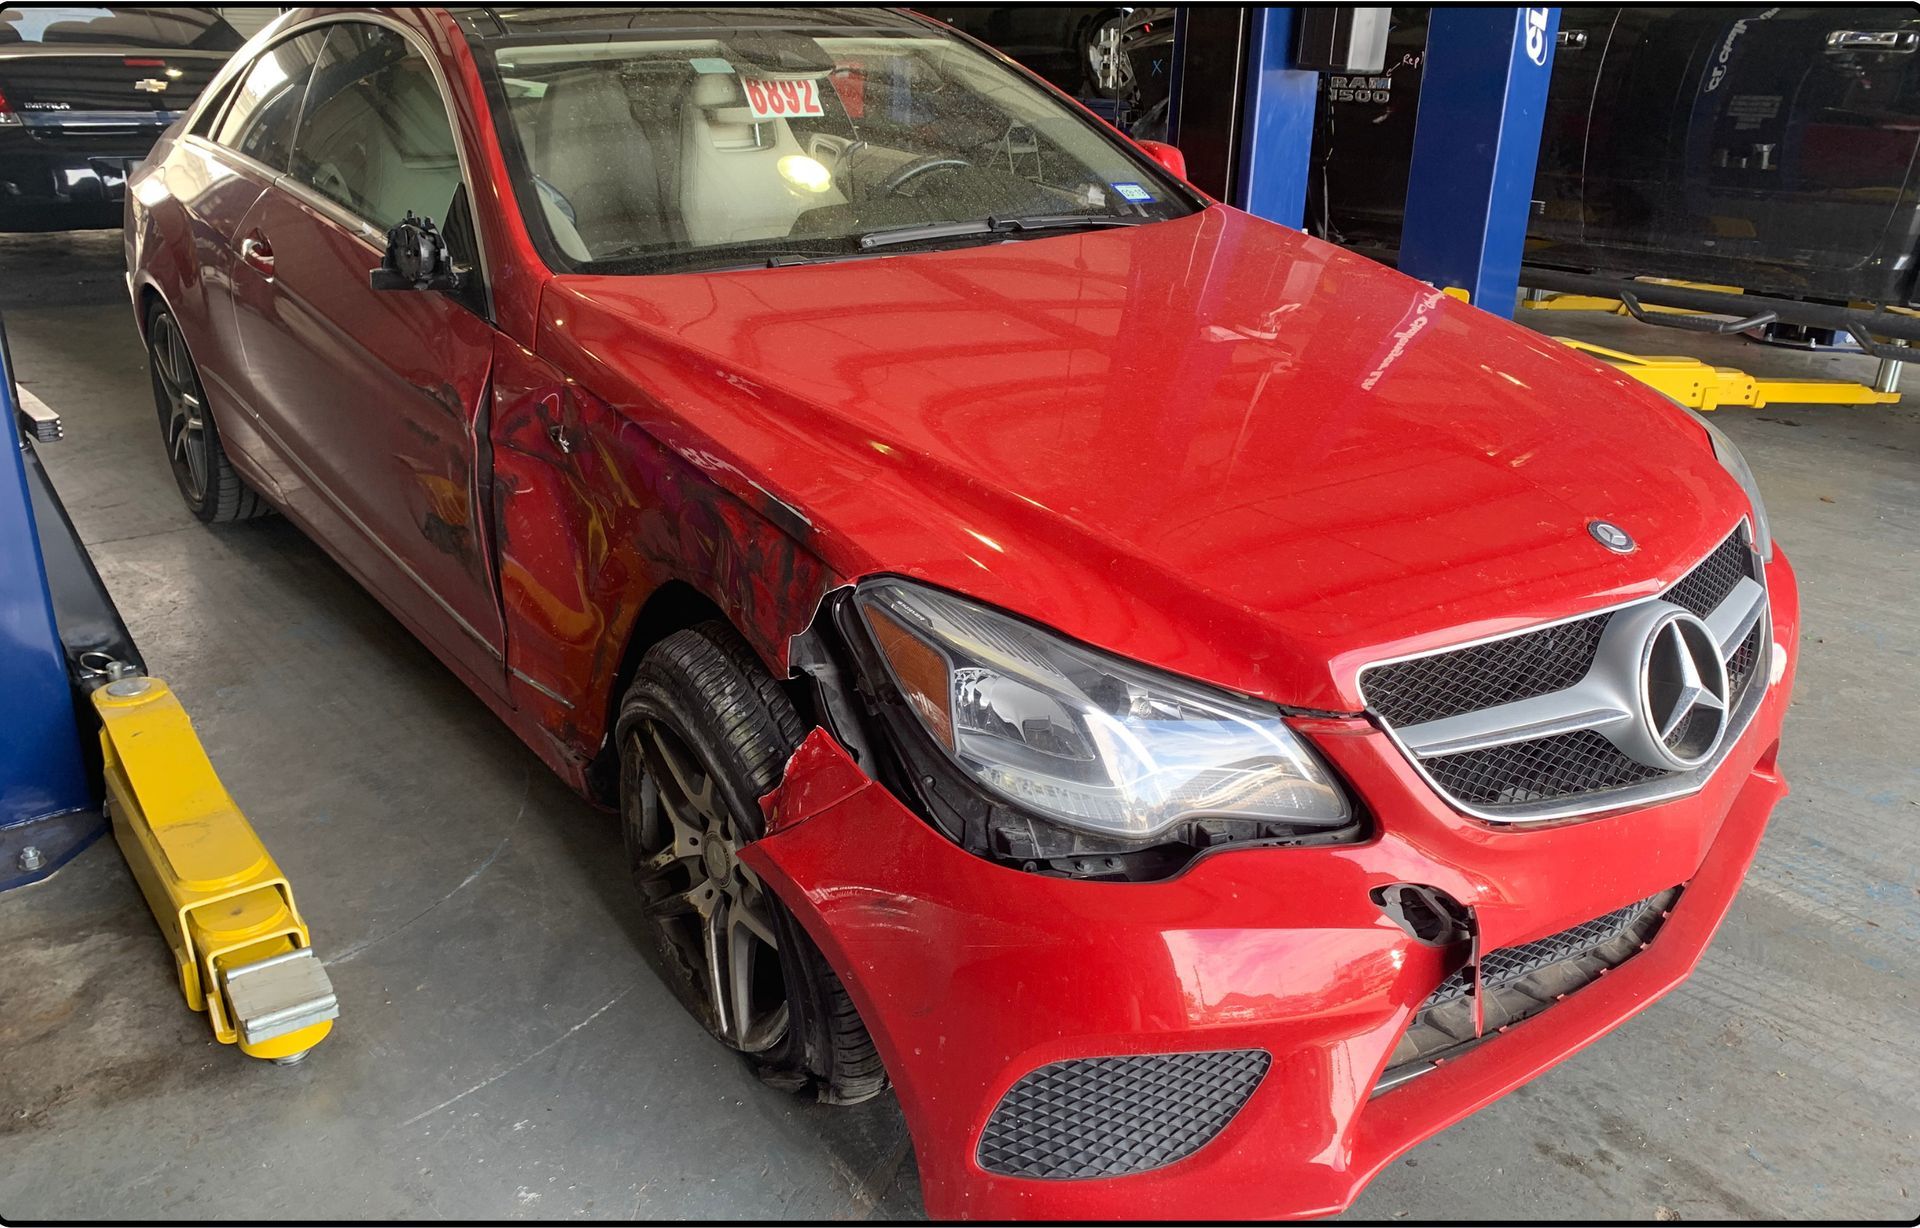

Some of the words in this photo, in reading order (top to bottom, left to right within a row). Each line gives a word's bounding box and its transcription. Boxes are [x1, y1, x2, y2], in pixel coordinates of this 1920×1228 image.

[1331, 76, 1391, 90] RAM
[744, 76, 820, 115] 6892
[1330, 89, 1390, 103] 1500
